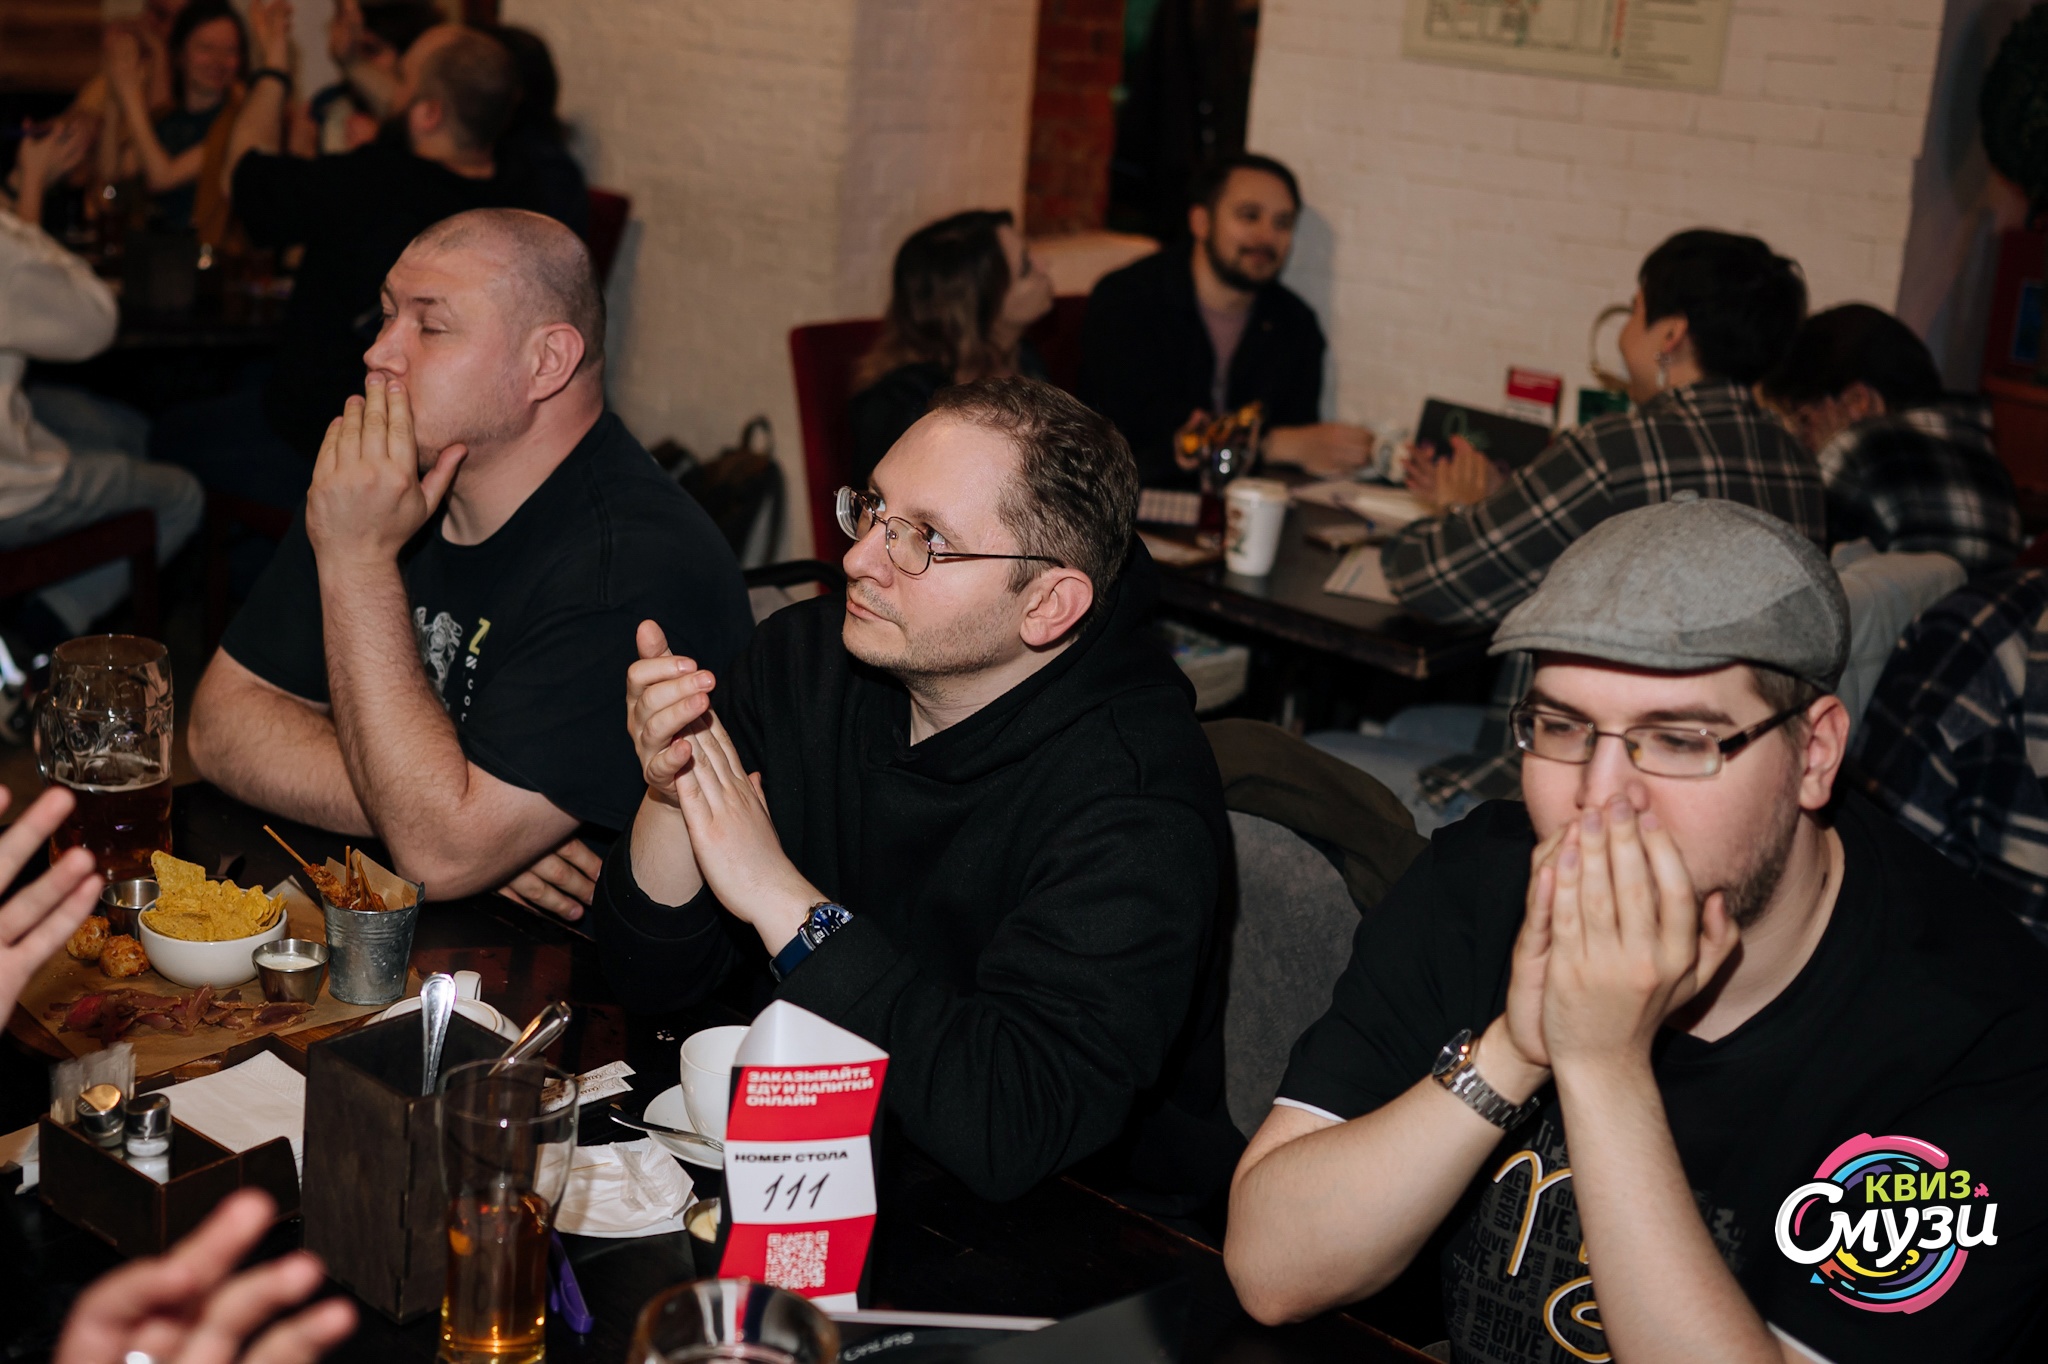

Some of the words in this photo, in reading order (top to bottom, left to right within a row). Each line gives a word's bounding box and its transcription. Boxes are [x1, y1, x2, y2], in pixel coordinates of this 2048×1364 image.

[747, 1066, 871, 1083] ЗАКАЗЫВАЙТЕ
[746, 1083, 782, 1096] ЕДУ
[783, 1082, 795, 1095] И
[797, 1077, 874, 1095] НАПИТКИ
[745, 1093, 818, 1107] ОНЛАЙН
[734, 1153, 792, 1164] НОМЕР
[795, 1150, 849, 1162] СТОЛА
[1477, 1276, 1505, 1298] GIVE
[1508, 1287, 1526, 1303] UP
[1476, 1293, 1523, 1325] NEVER
[1468, 1308, 1493, 1352] NEVER
[1491, 1317, 1546, 1360] GIVE
